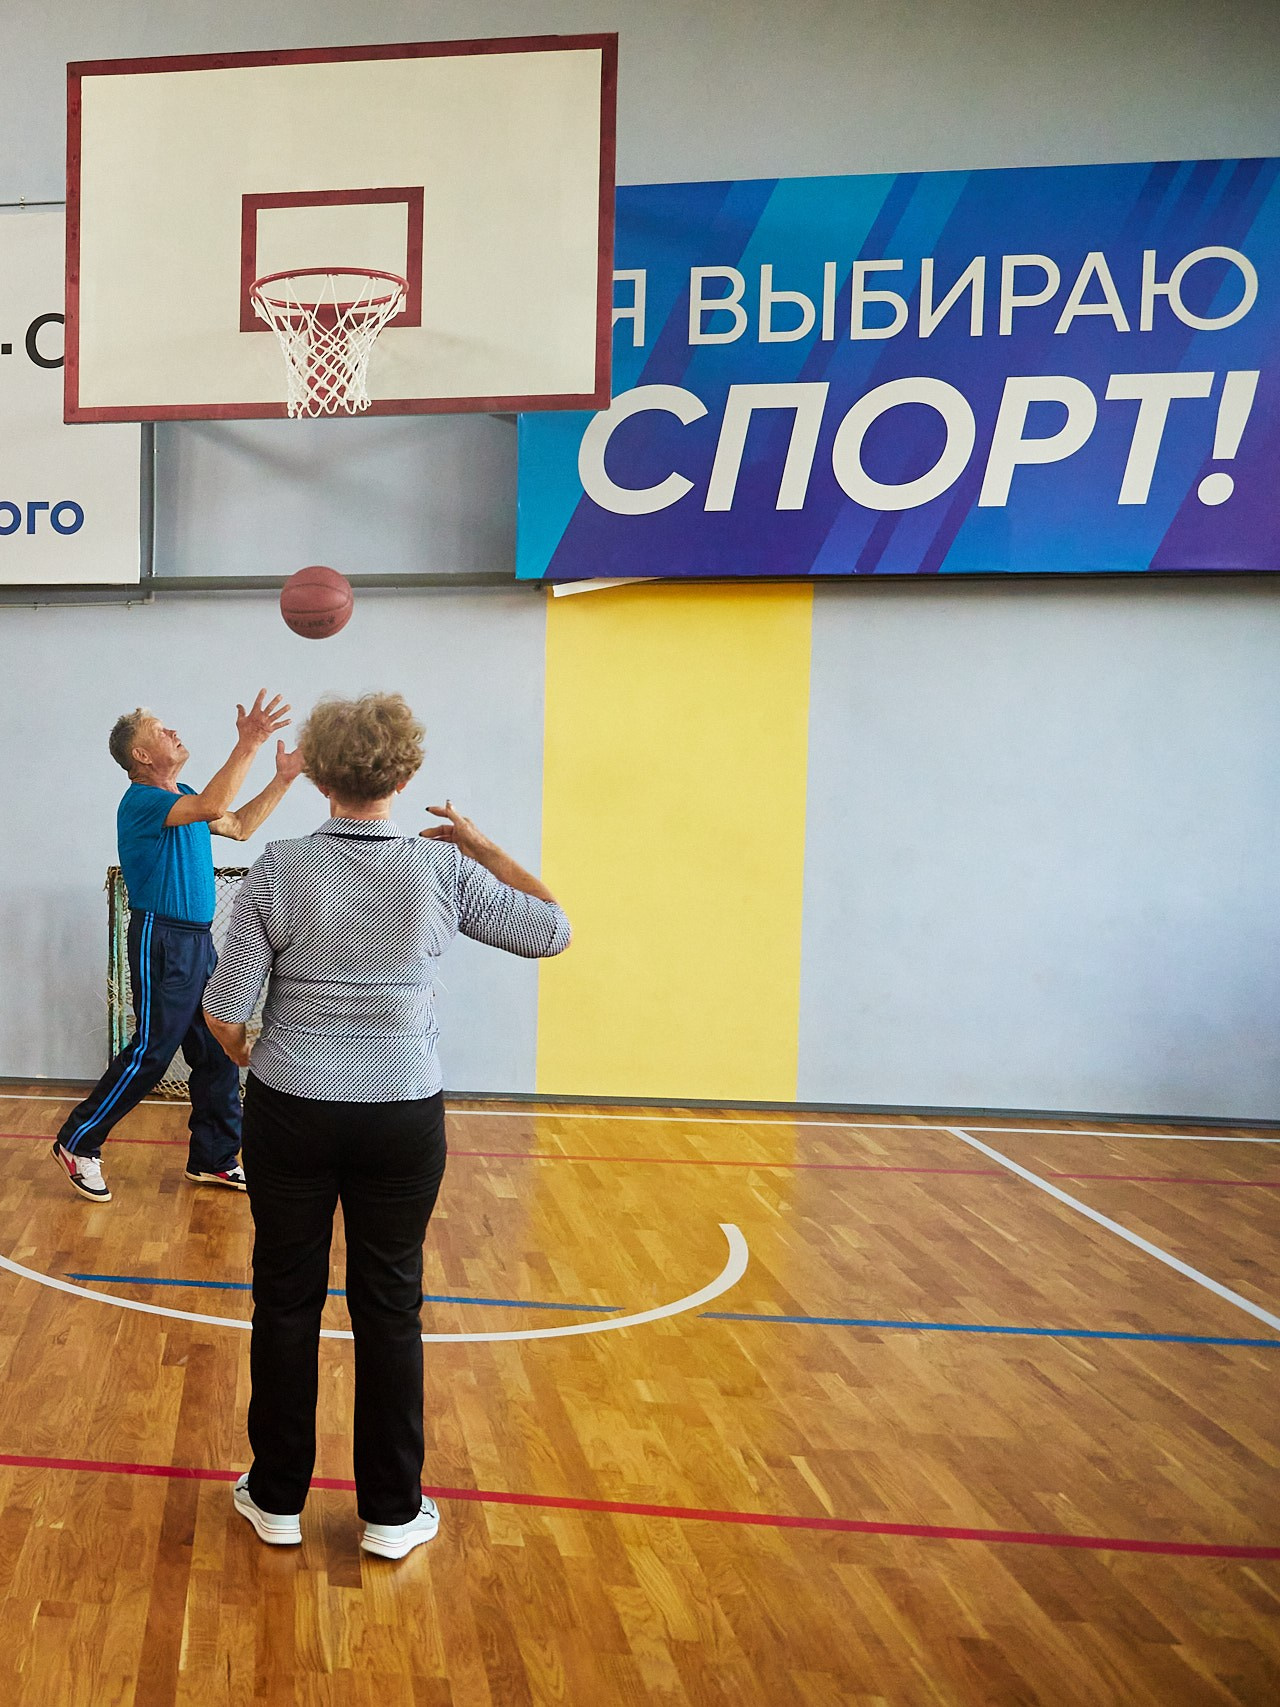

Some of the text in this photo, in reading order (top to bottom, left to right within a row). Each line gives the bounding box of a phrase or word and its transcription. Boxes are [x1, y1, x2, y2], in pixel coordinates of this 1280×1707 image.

[612, 246, 1259, 347] Я ВЫБИРАЮ
[577, 370, 1260, 515] СПОРТ!
